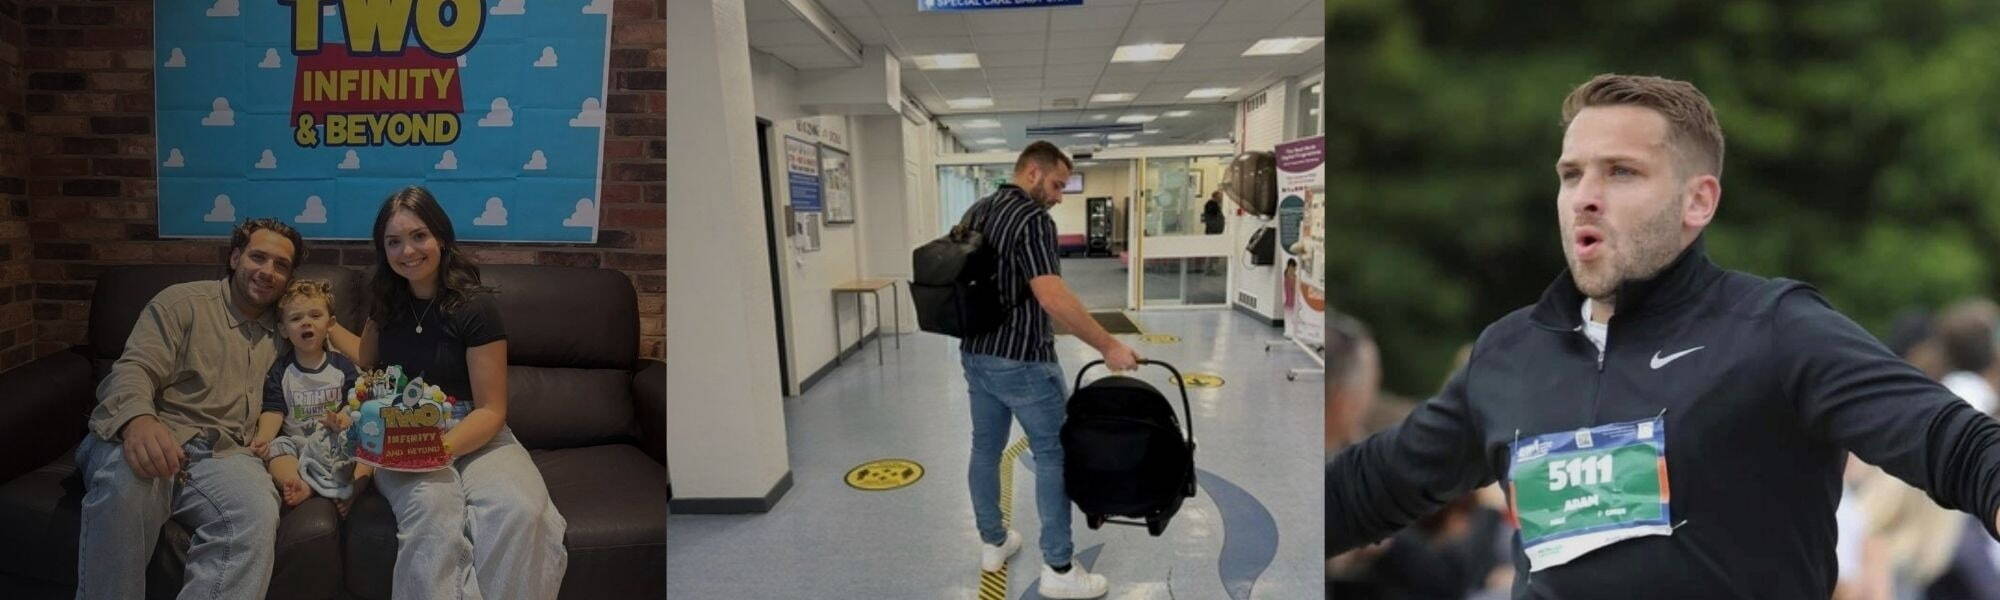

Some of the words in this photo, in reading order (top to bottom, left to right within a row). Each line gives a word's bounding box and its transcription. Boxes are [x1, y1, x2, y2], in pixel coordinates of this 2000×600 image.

[278, 0, 484, 56] TWO
[303, 68, 455, 101] INFINITY
[296, 113, 318, 146] &
[325, 112, 459, 144] BEYOND
[379, 402, 441, 429] TWO
[387, 433, 437, 444] INFINITY
[1549, 454, 1613, 491] 5111
[1564, 495, 1600, 512] ADAM
